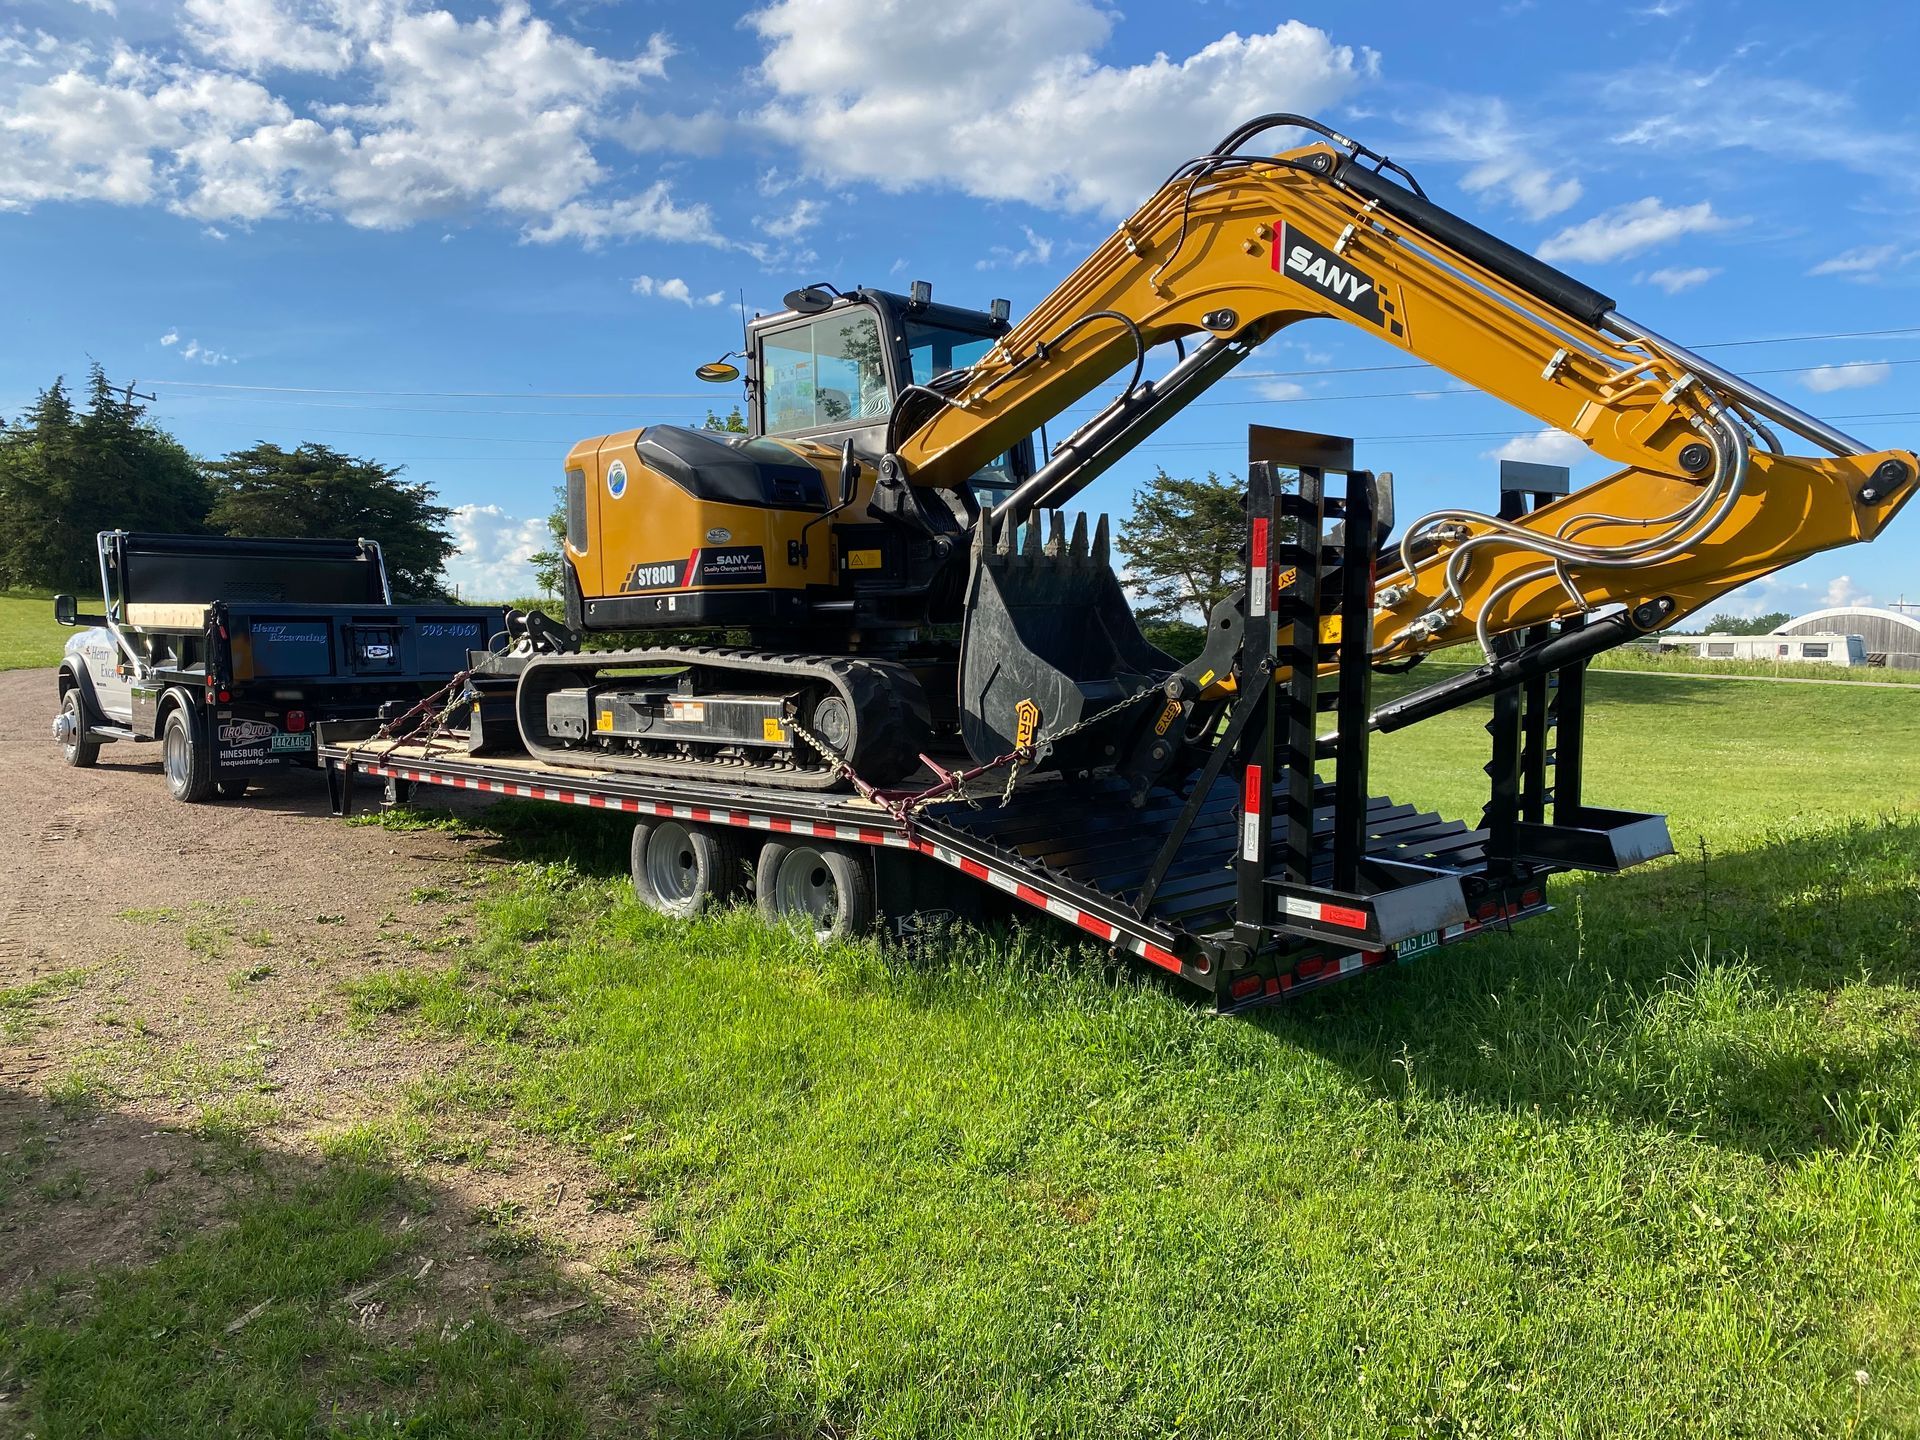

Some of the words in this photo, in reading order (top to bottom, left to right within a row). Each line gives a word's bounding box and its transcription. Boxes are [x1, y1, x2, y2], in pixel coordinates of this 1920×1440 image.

[1286, 245, 1372, 302] SANY
[716, 555, 750, 565] SANY
[703, 566, 720, 574] Quality
[720, 565, 739, 573] Changes
[638, 565, 676, 586] SY80U
[251, 623, 287, 634] Henry
[268, 633, 327, 643] Excavating
[1018, 708, 1033, 747] GRY
[220, 748, 264, 759] HINESBURG
[220, 758, 280, 767] iroquoismfg.com
